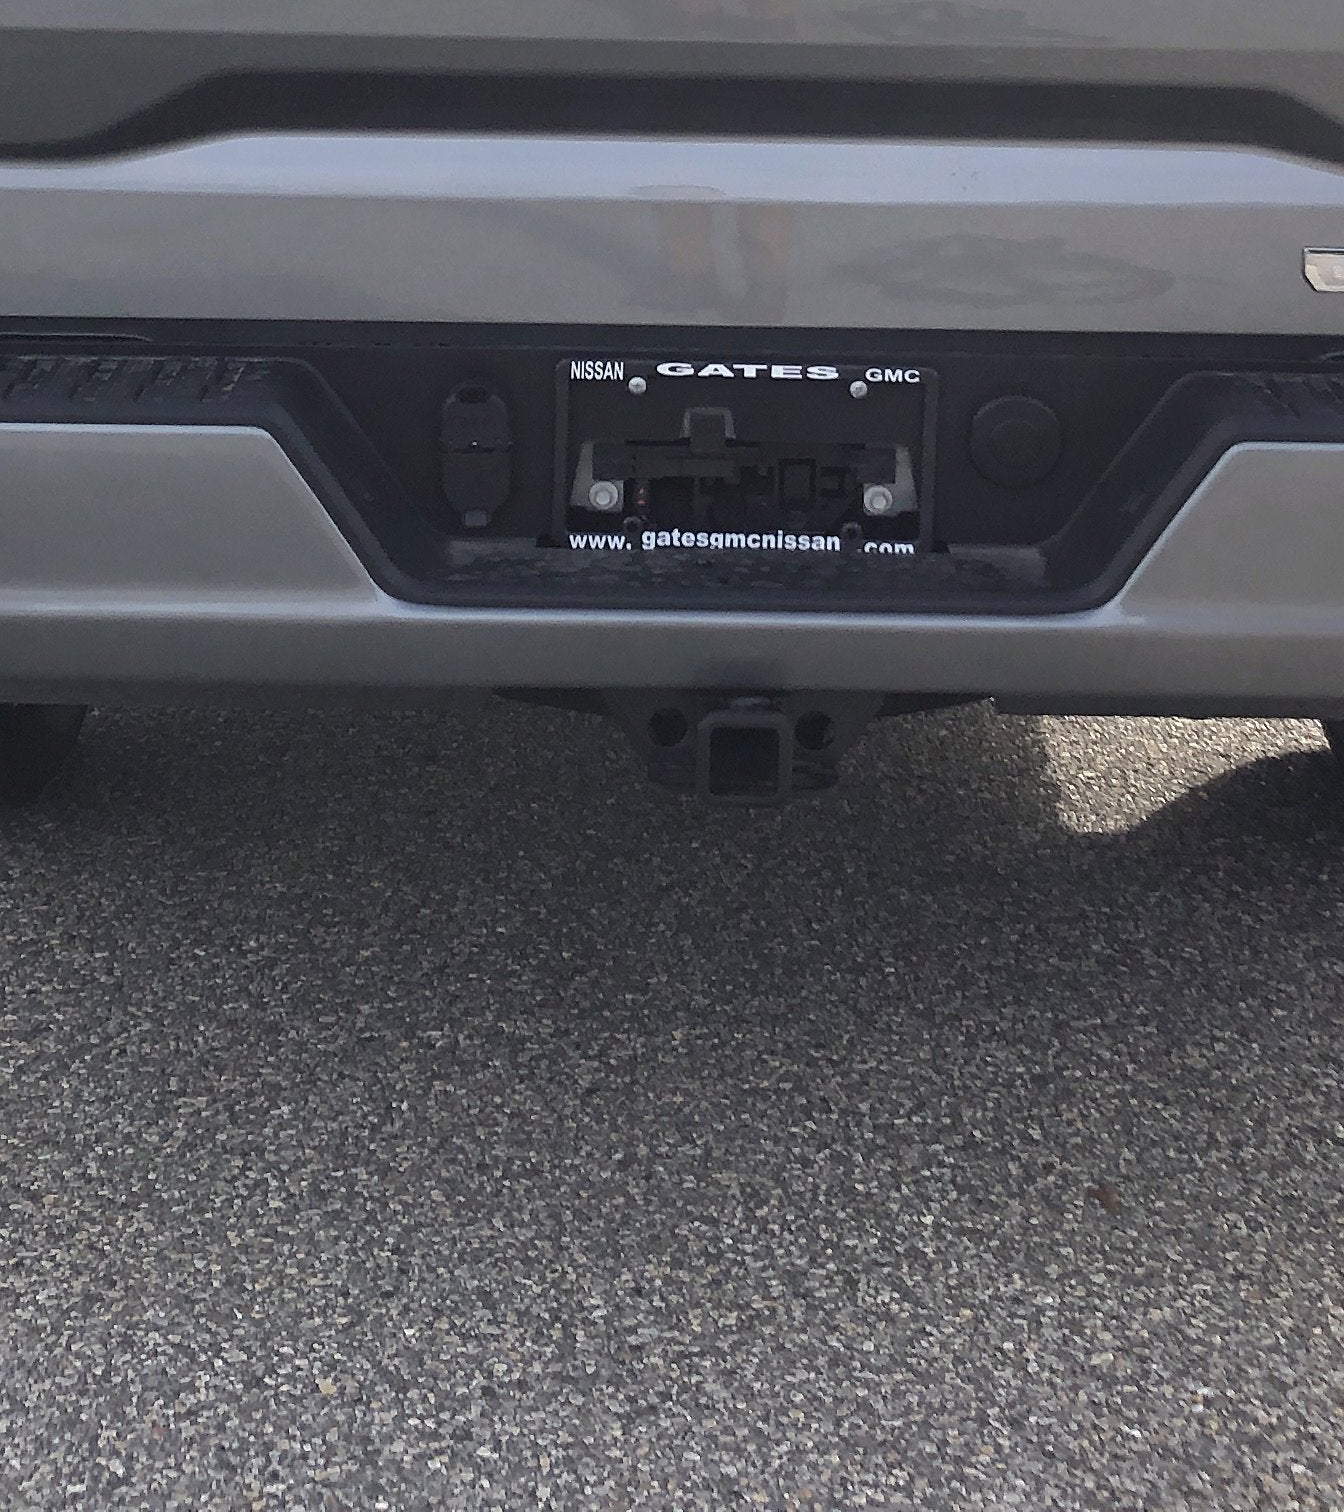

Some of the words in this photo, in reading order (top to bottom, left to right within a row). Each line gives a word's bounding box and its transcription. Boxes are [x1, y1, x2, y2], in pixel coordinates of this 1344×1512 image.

[570, 360, 624, 381] NISSAN
[656, 362, 839, 380] GATES
[865, 368, 920, 383] GMC
